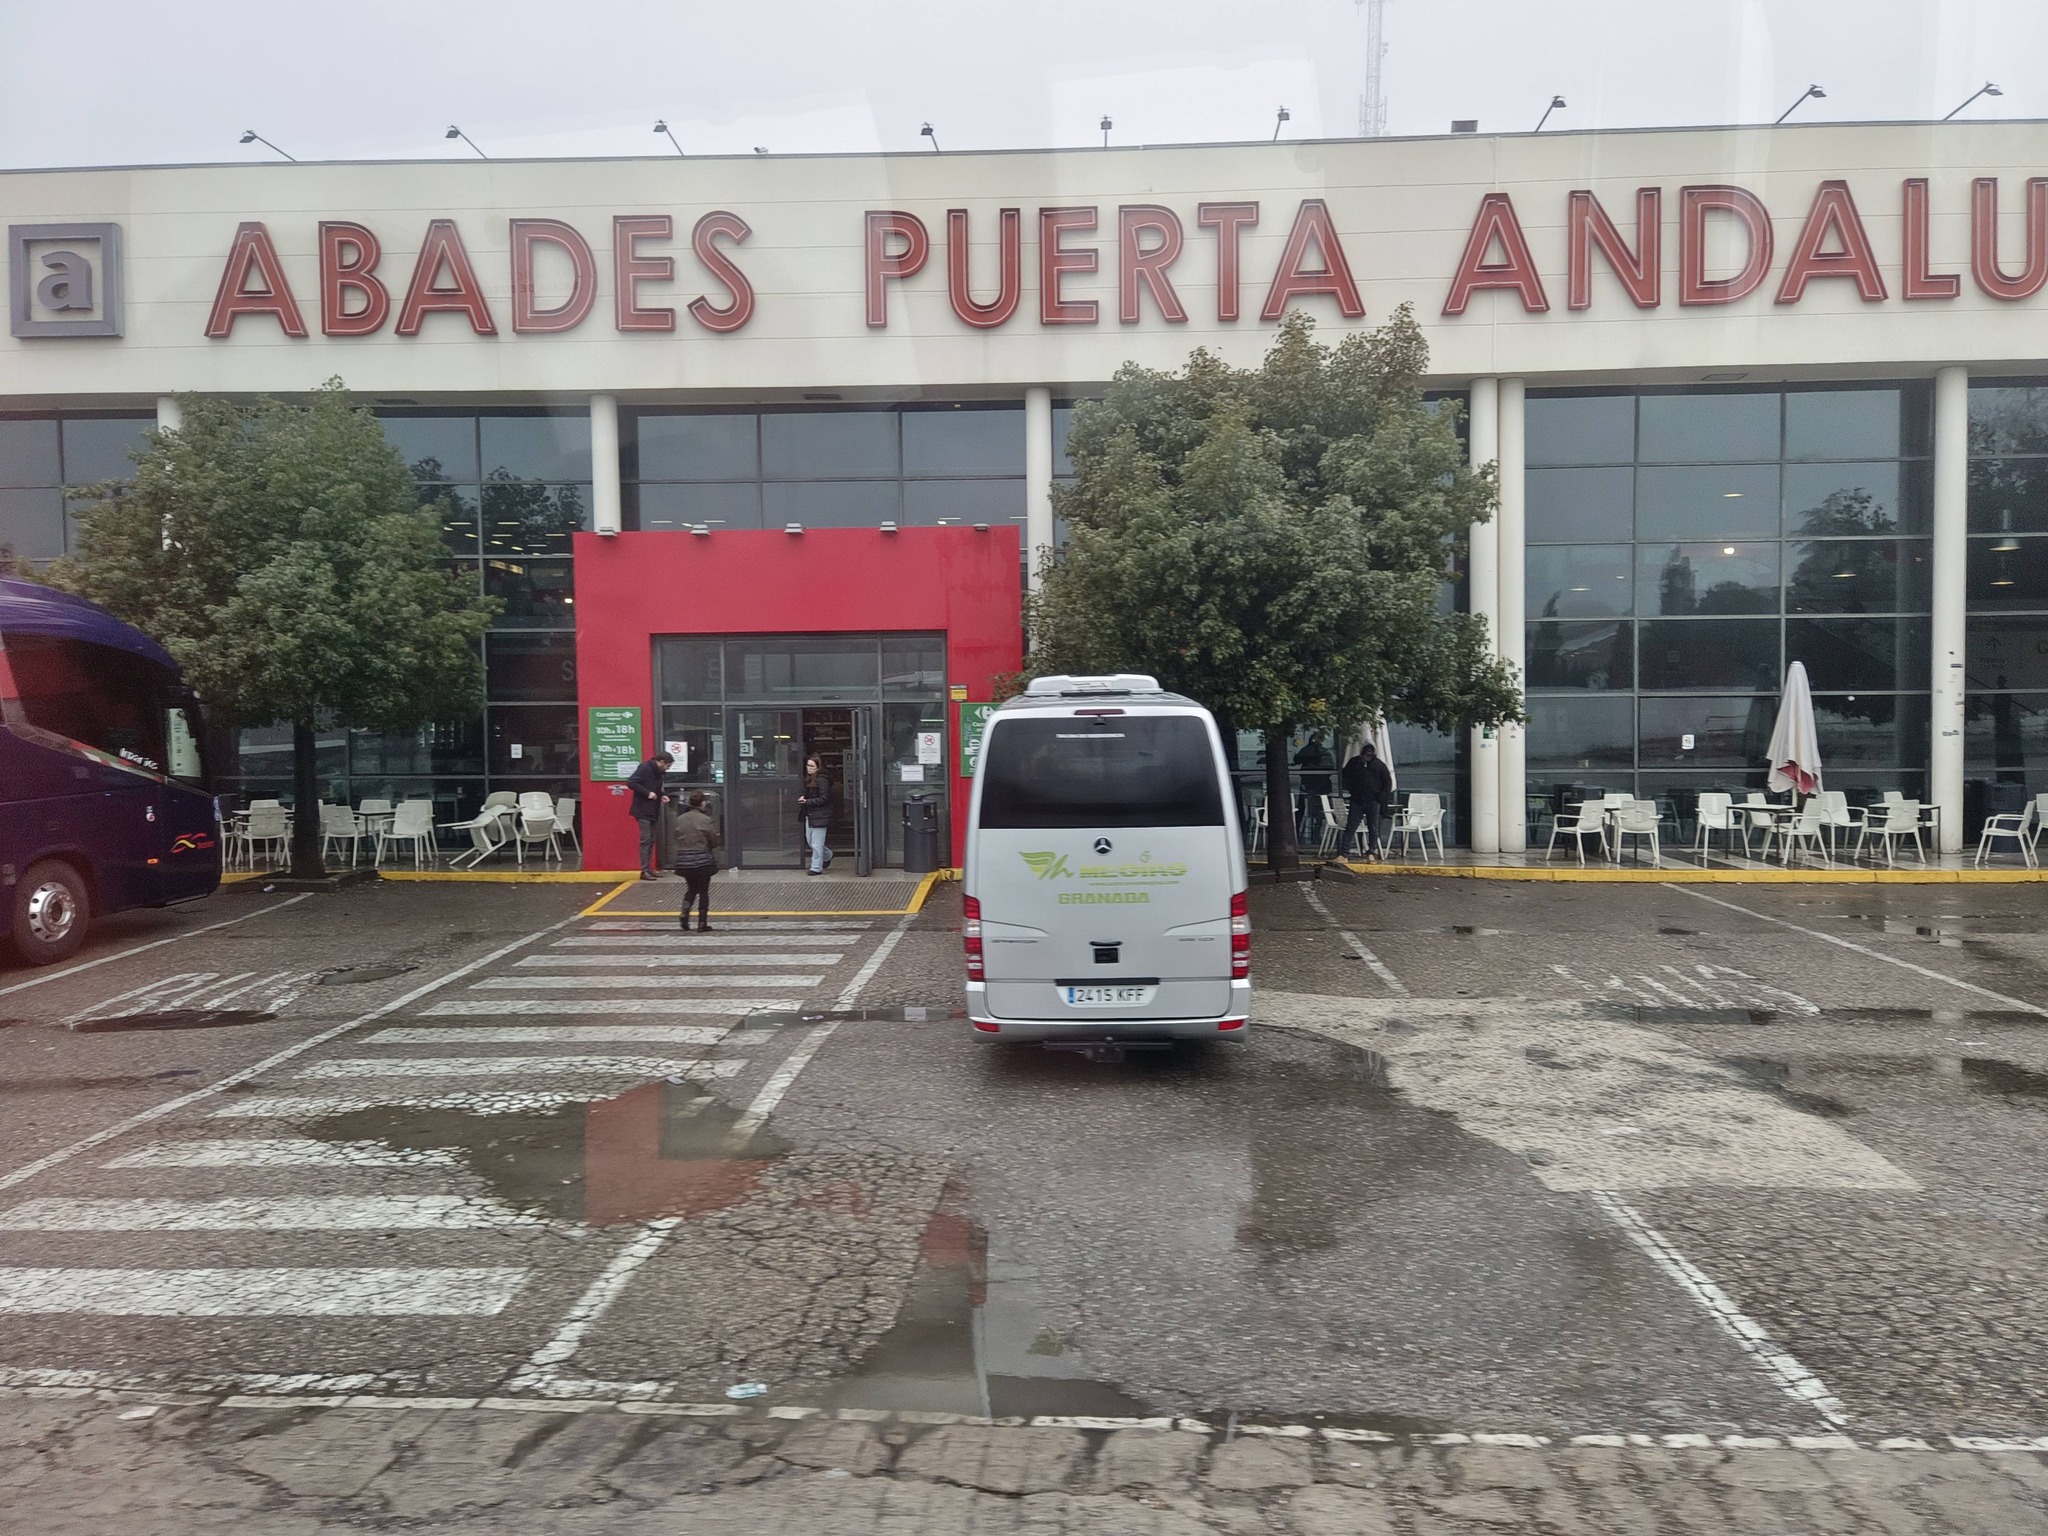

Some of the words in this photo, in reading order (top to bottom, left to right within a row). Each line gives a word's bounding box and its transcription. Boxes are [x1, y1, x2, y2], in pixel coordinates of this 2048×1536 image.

[205, 210, 754, 338] ABADES
[865, 198, 1366, 329] PUERTA
[1440, 177, 2048, 316] ANDALU
[1058, 892, 1150, 904] GRANADA
[1076, 988, 1113, 1002] 2415
[1116, 988, 1146, 1002] KFF
